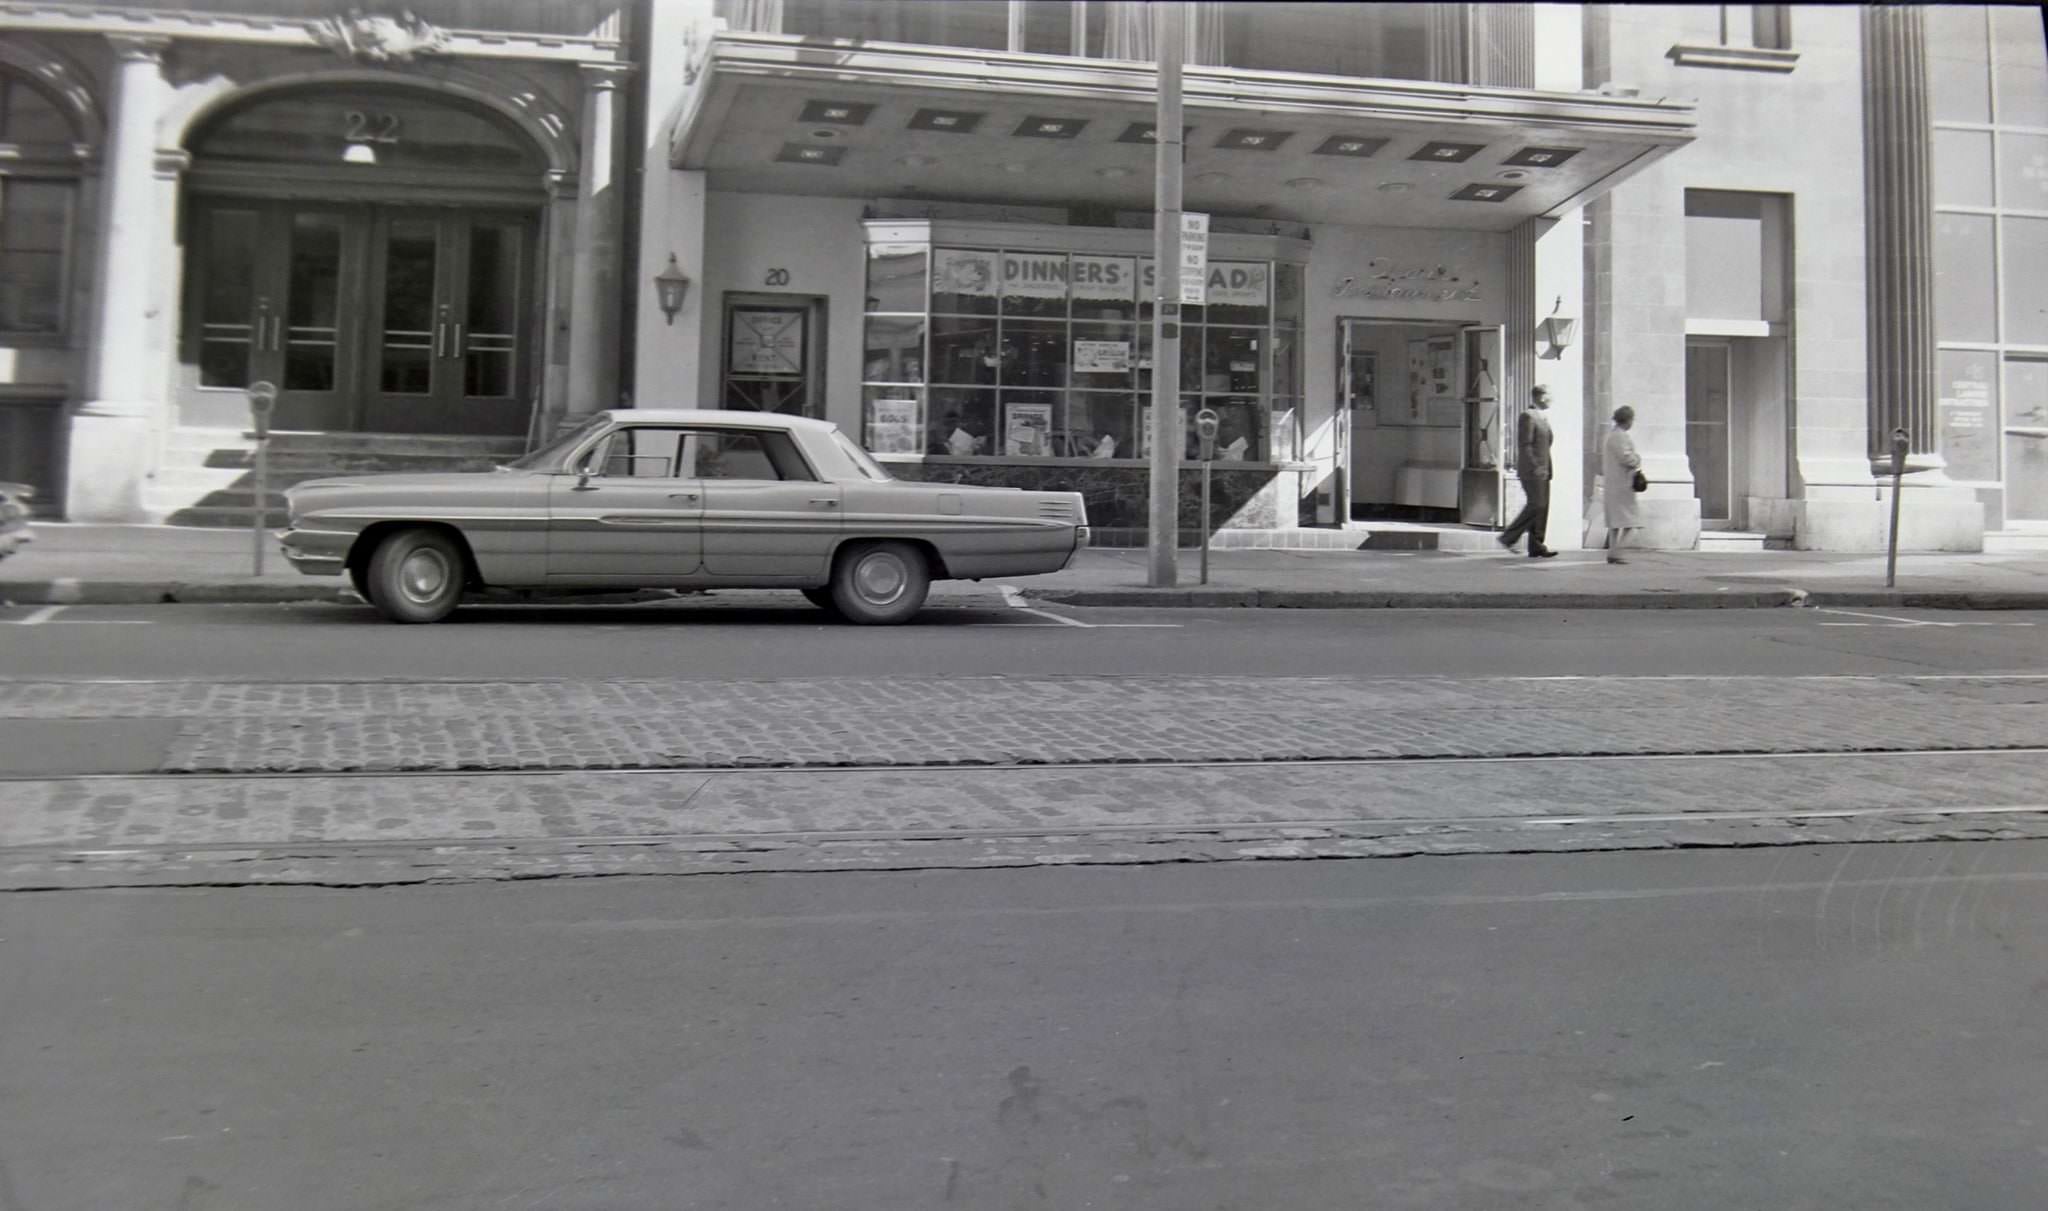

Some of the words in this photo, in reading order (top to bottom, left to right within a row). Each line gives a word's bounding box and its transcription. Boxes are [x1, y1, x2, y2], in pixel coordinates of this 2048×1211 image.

[344, 110, 398, 143] 22
[1187, 220, 1200, 230] NO
[1186, 254, 1199, 265] NO
[765, 268, 790, 286] 20
[1004, 259, 1121, 285] DINNERS
